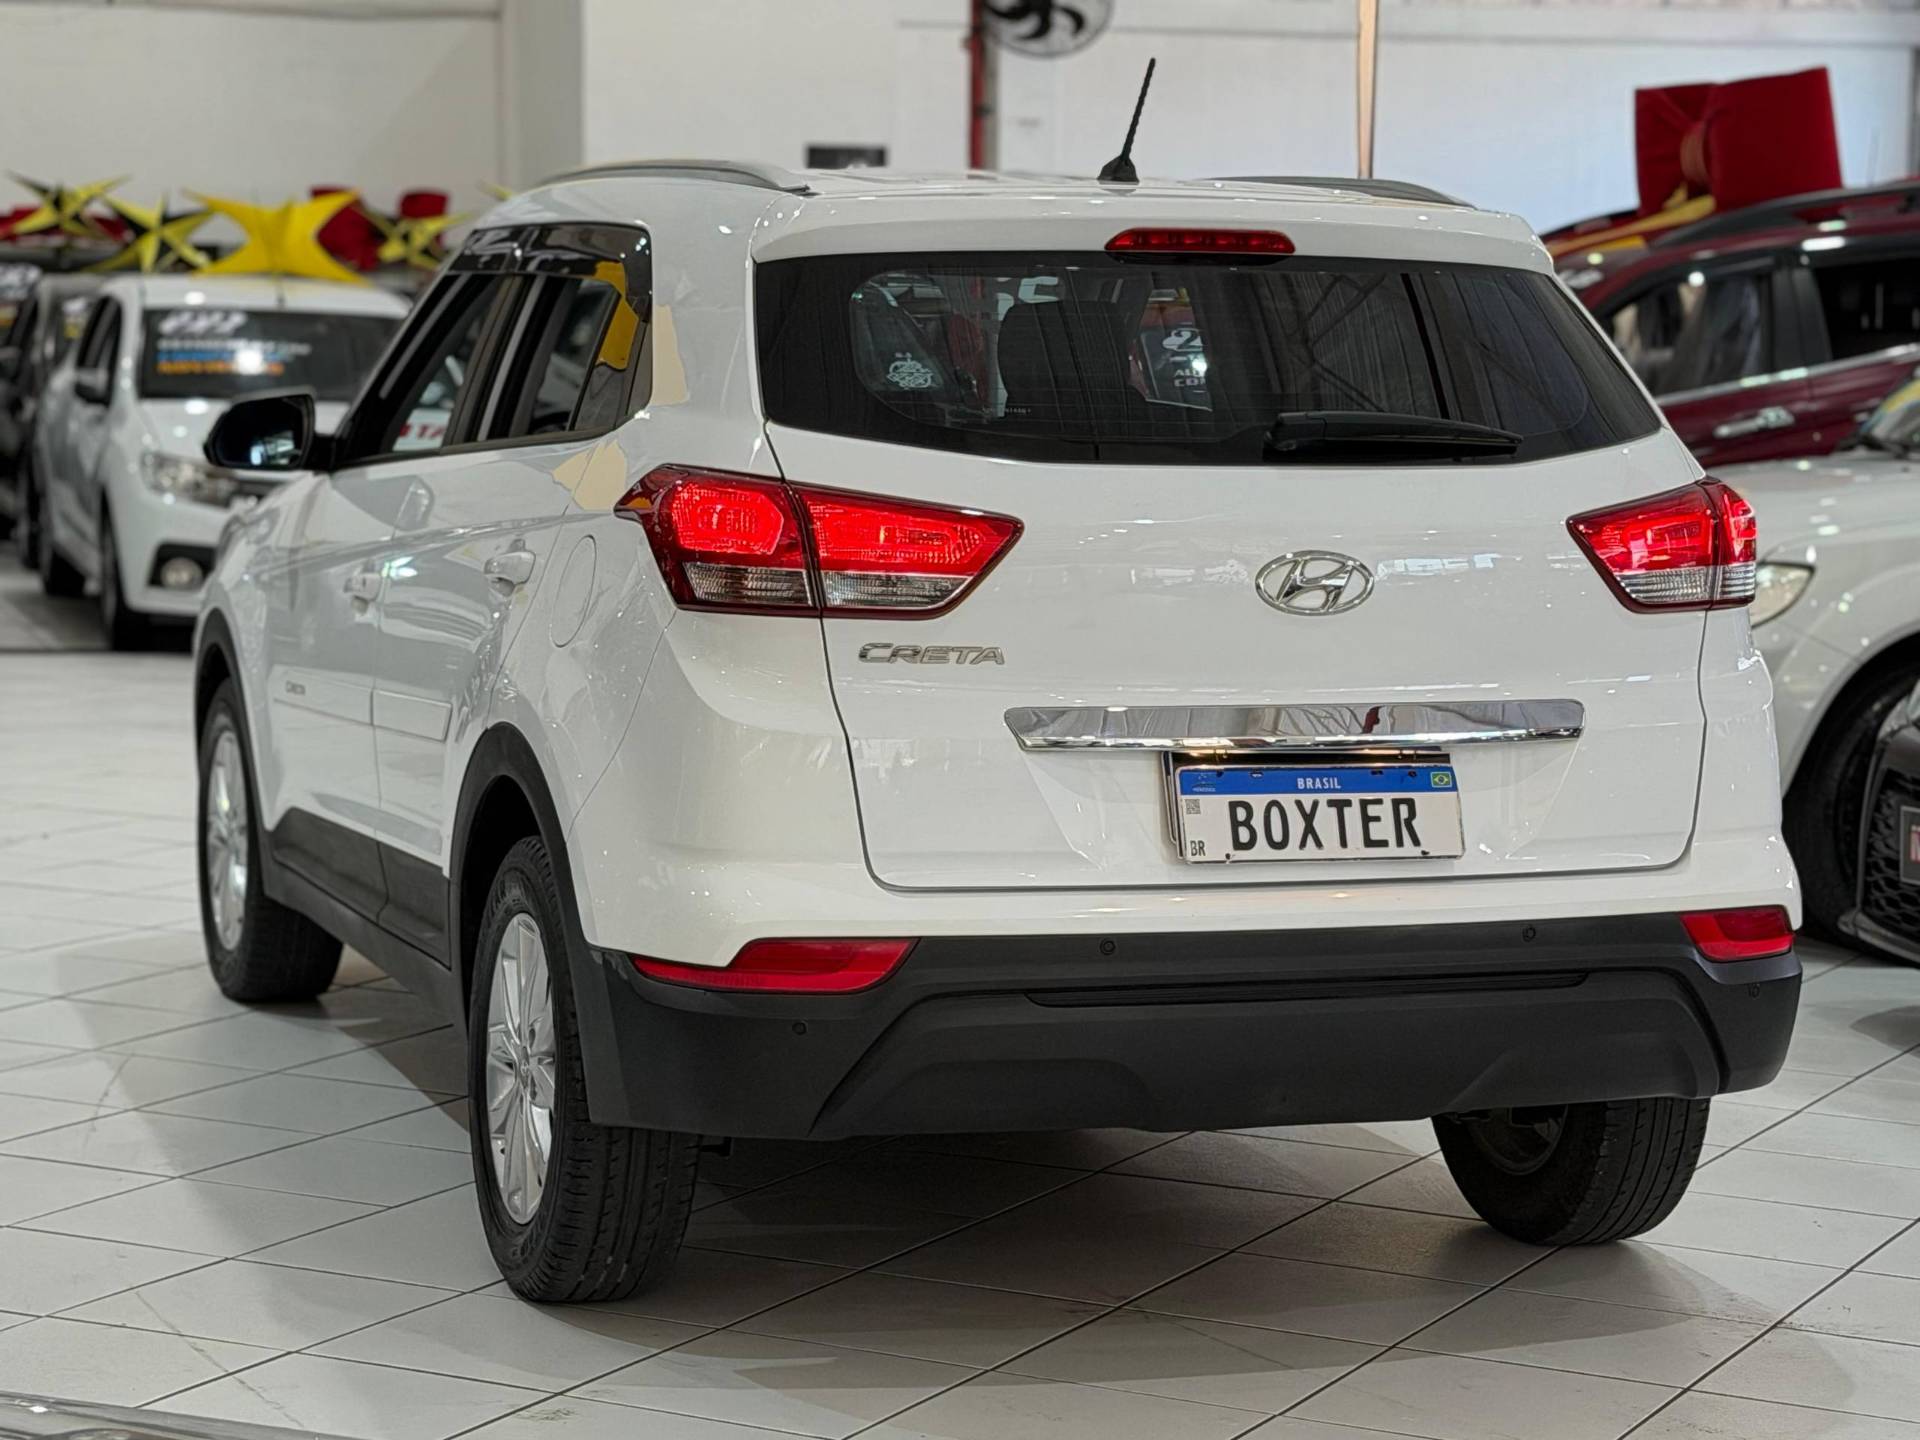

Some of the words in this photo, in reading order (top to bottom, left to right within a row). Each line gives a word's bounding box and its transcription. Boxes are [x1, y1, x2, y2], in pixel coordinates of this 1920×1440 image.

[858, 642, 1005, 664] CRETA
[1296, 777, 1342, 790] BRASIL
[1228, 797, 1422, 851] BOXTER
[1190, 840, 1206, 857] BR
